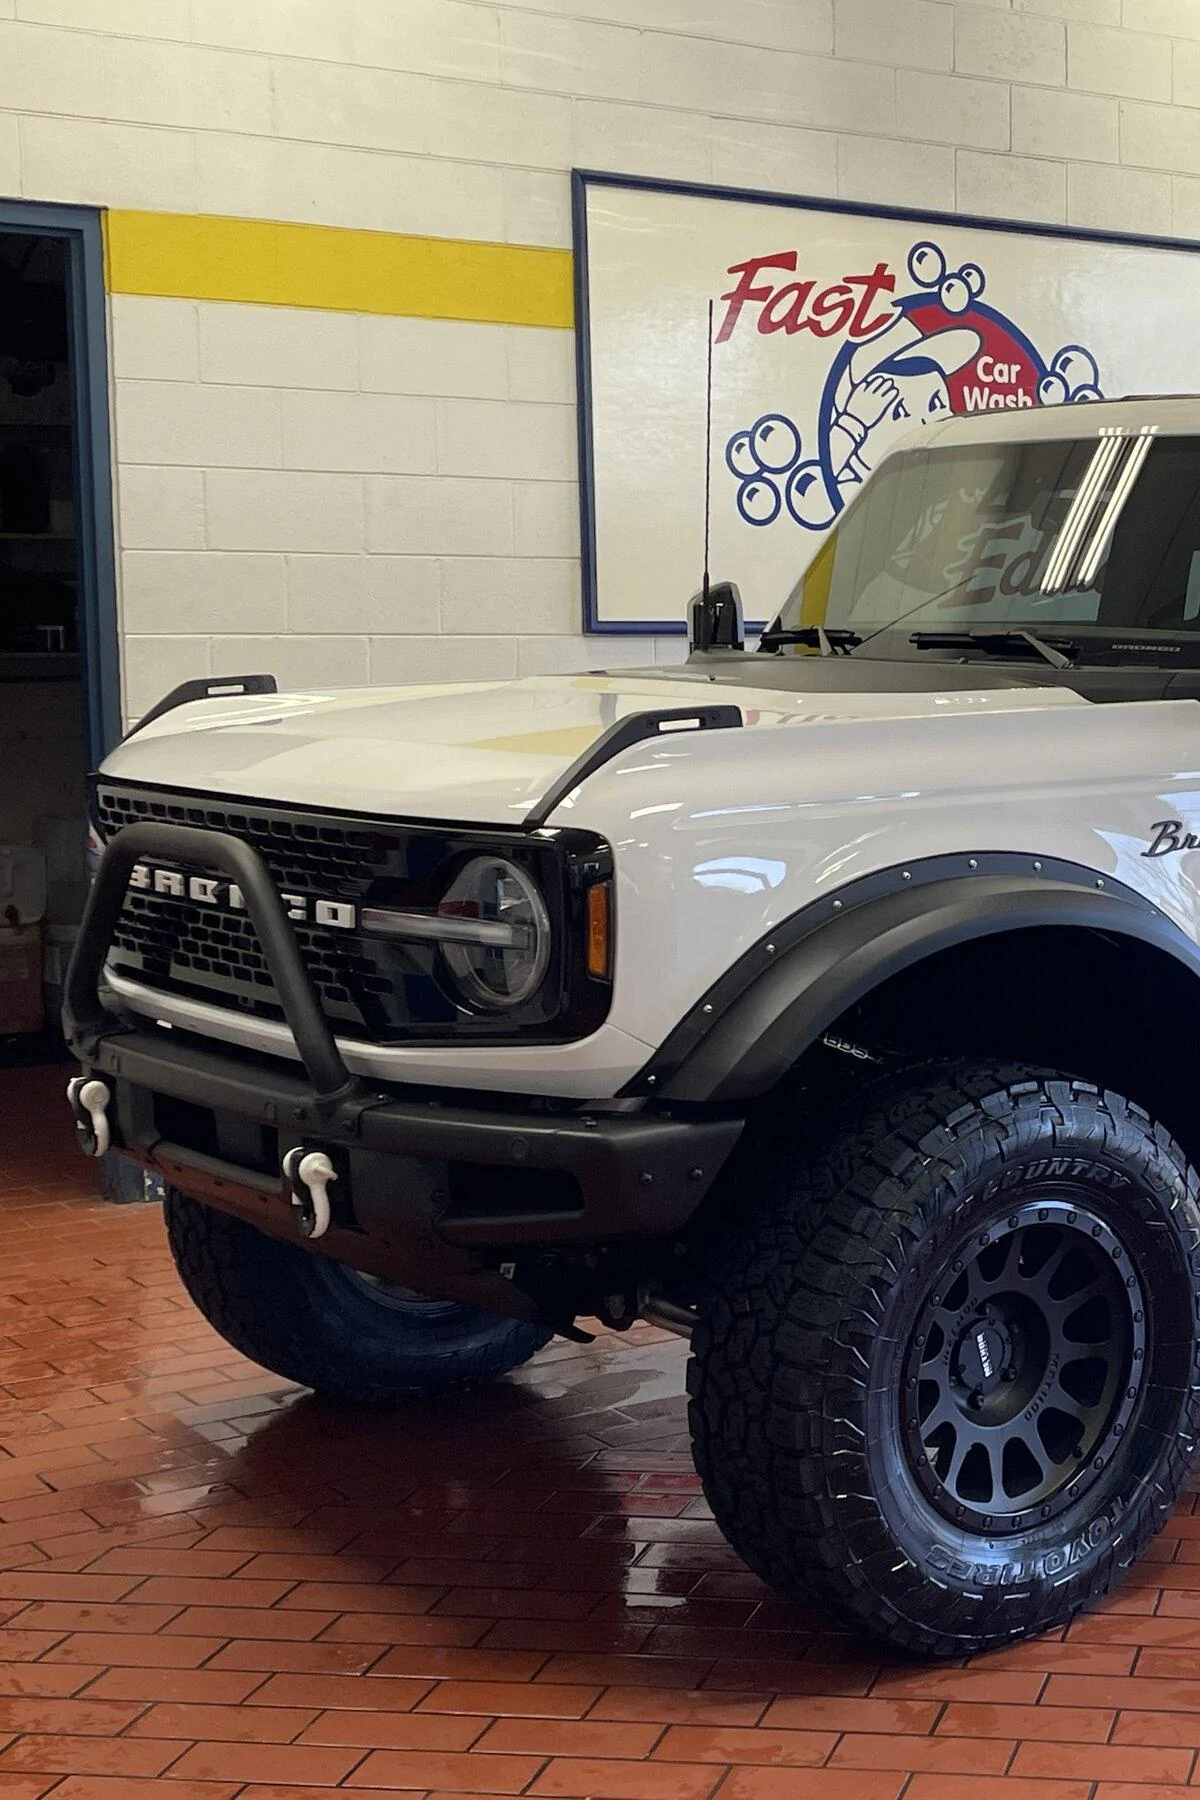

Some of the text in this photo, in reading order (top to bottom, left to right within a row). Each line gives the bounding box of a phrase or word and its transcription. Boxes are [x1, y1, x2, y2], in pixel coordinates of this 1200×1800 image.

[715, 250, 897, 345] Fast
[976, 354, 1022, 384] Car
[983, 1155, 1132, 1201] COUNTRY
[924, 1495, 1132, 1586] TOYO TIRES
